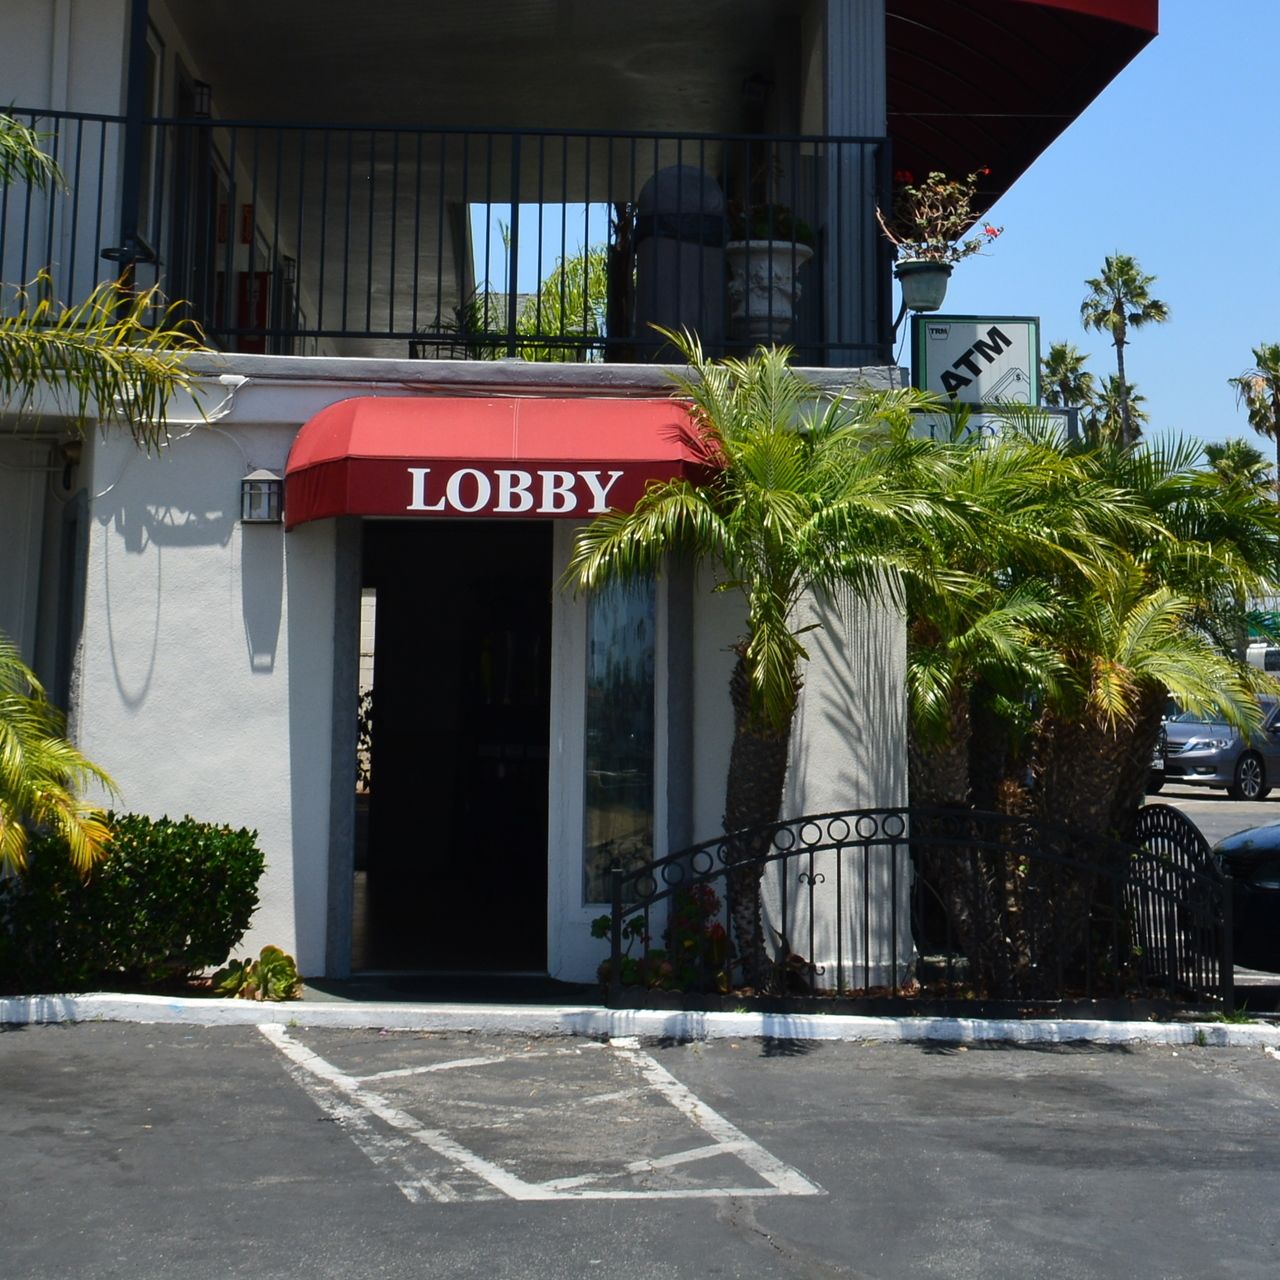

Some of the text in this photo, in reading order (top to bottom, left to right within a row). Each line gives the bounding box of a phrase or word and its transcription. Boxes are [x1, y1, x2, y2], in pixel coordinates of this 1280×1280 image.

[929, 327, 948, 335] TRM
[939, 325, 1013, 400] ATM
[406, 467, 625, 513] LOBBY
